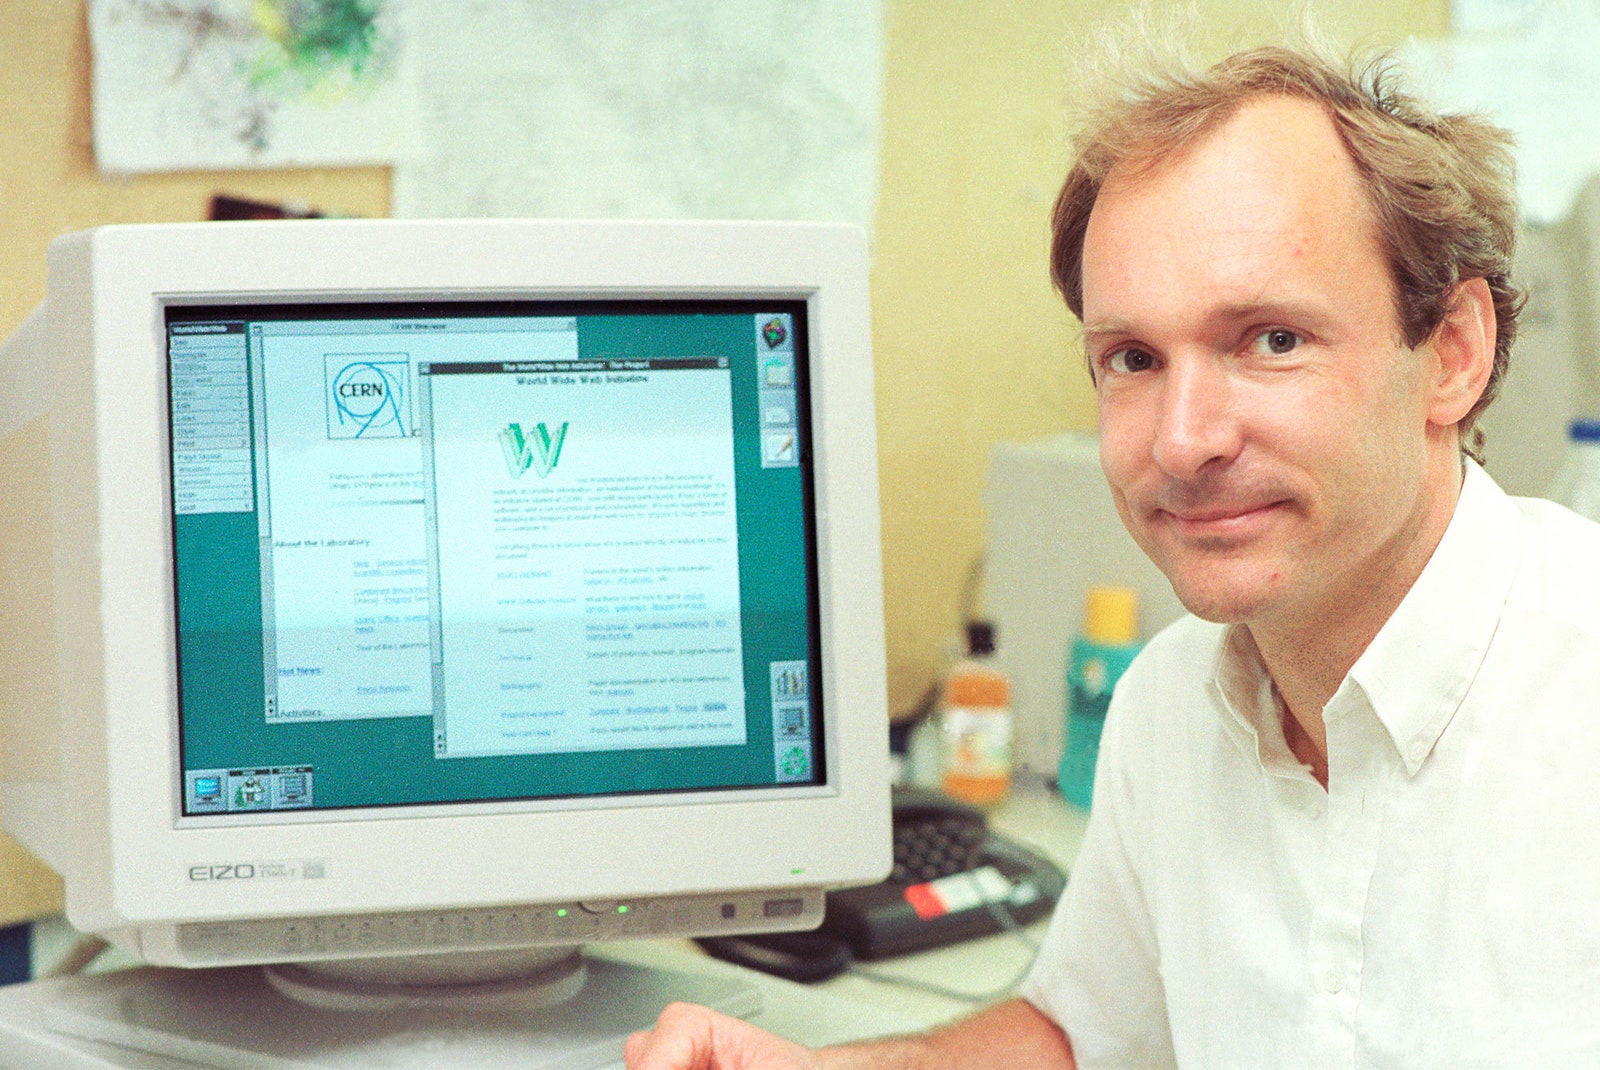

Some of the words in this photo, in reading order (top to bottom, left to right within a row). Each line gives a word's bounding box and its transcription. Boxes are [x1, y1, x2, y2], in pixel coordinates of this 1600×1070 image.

[516, 376, 548, 386] World
[551, 375, 576, 385] Wide
[580, 375, 603, 385] Web
[339, 382, 383, 399] CERN
[296, 666, 321, 676] News
[189, 864, 255, 882] EIZO
